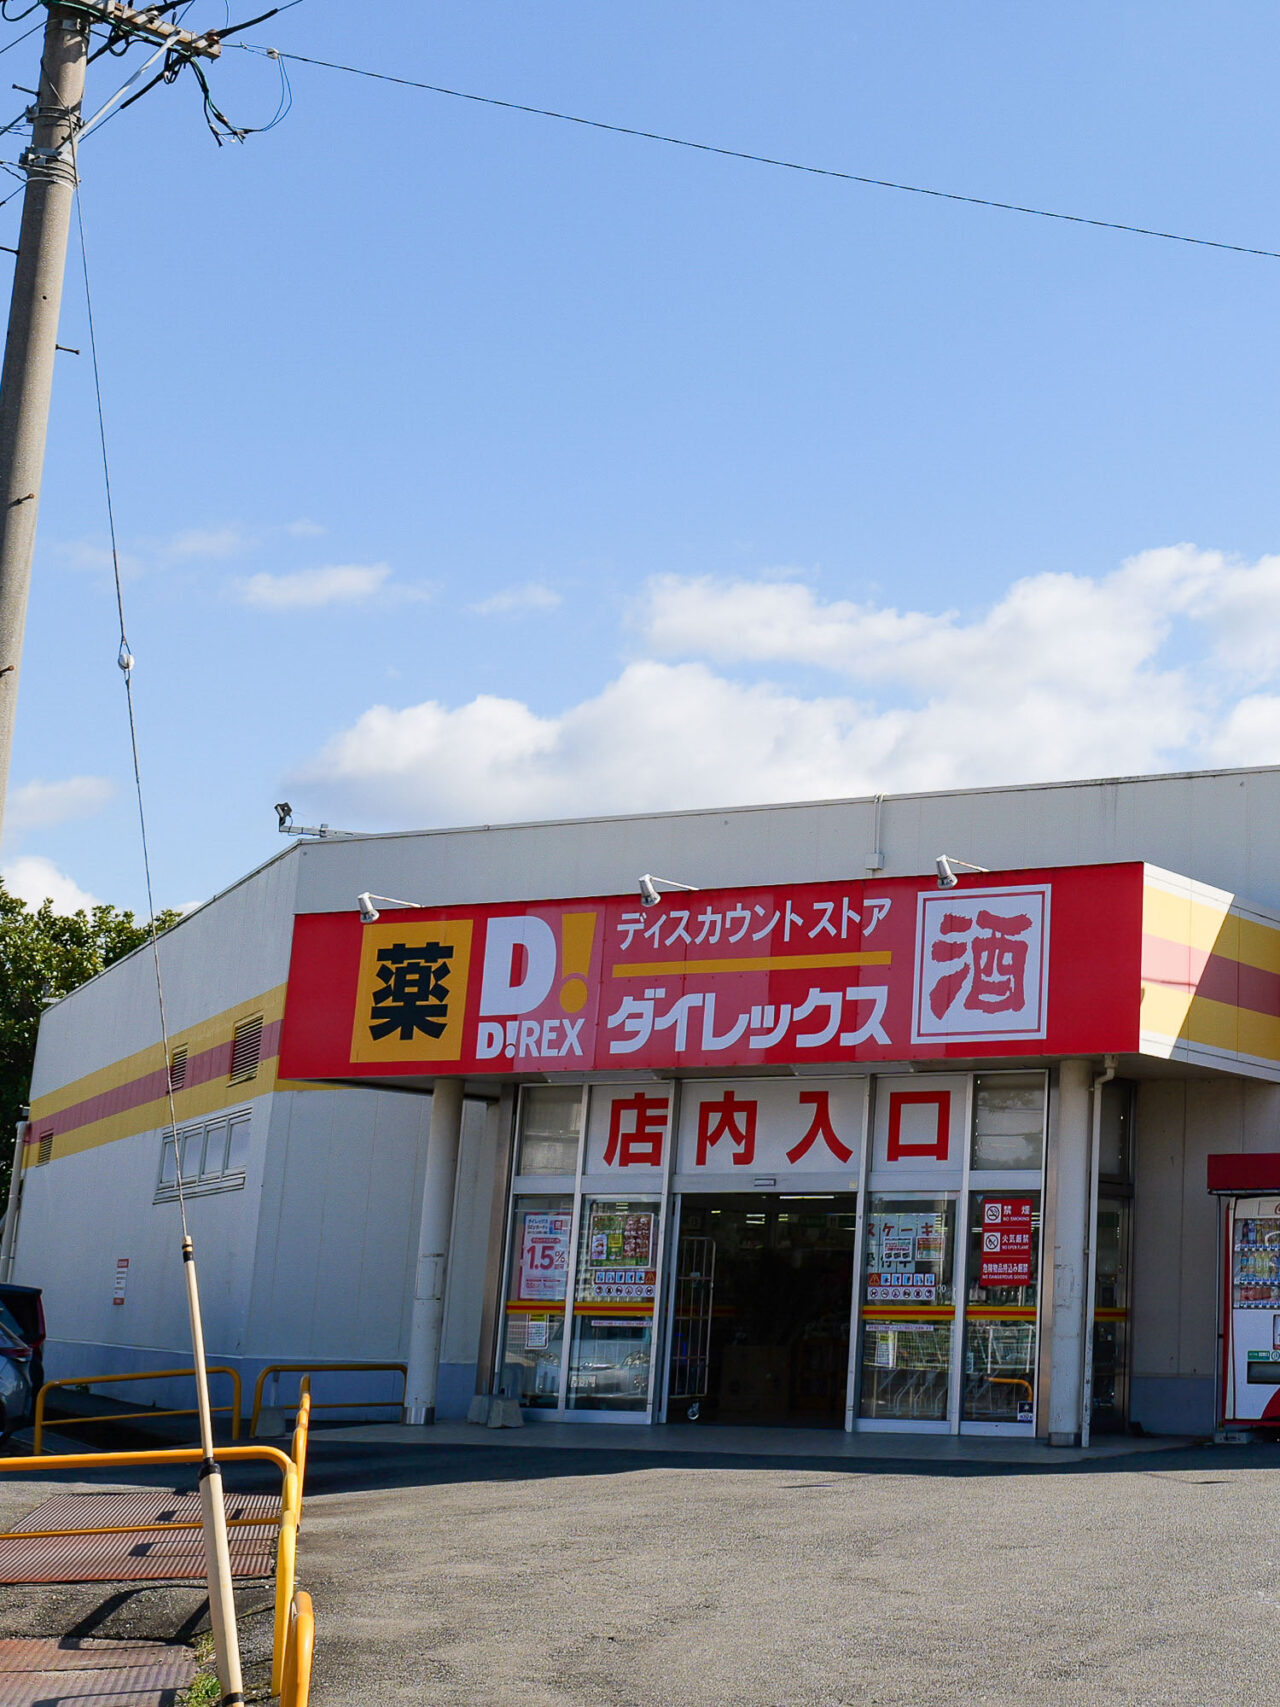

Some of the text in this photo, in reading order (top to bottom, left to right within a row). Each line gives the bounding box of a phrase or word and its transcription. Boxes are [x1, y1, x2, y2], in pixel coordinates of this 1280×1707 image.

[617, 896, 892, 950] ディスカウントストア
[368, 941, 454, 1041] 薬
[929, 909, 1033, 1020] 酒
[475, 1018, 585, 1060] D!REX
[607, 985, 893, 1054] ダイレックス
[603, 1090, 951, 1167] 店内入口
